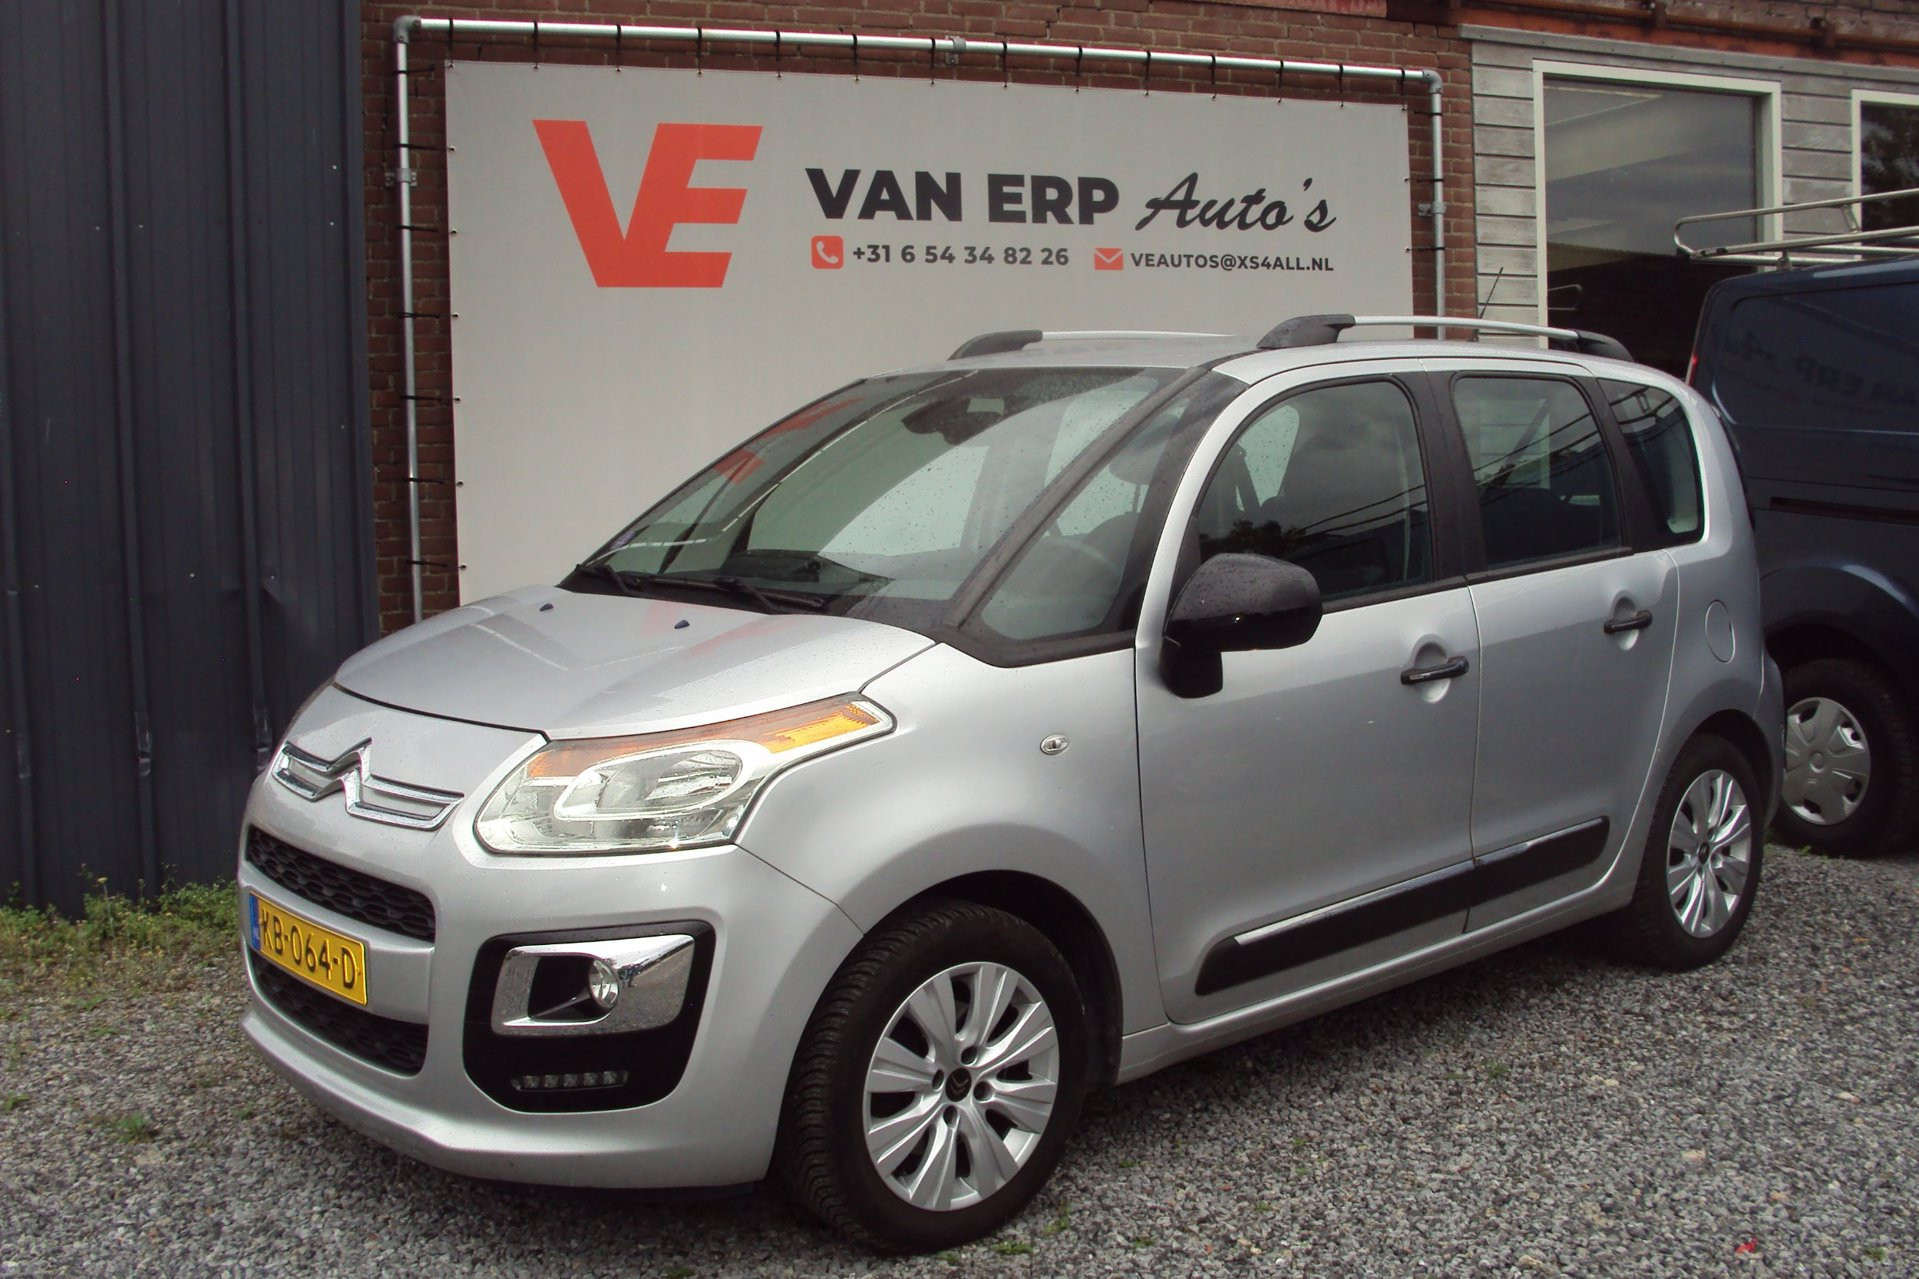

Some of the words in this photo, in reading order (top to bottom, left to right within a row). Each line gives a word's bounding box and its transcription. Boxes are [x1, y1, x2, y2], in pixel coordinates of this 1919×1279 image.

[532, 119, 763, 288] VE
[804, 167, 963, 222] VAN
[987, 173, 1122, 226] ERP
[1134, 171, 1337, 233] Auto's
[852, 244, 891, 263] +31
[900, 244, 916, 264] 6
[924, 245, 956, 264] 54
[964, 246, 995, 265] 34
[1003, 246, 1033, 265] 82
[1040, 247, 1070, 266] 26
[1130, 252, 1335, 272] VEAUTOS@XS4ALL.NL
[260, 906, 358, 990] KB-064-D
